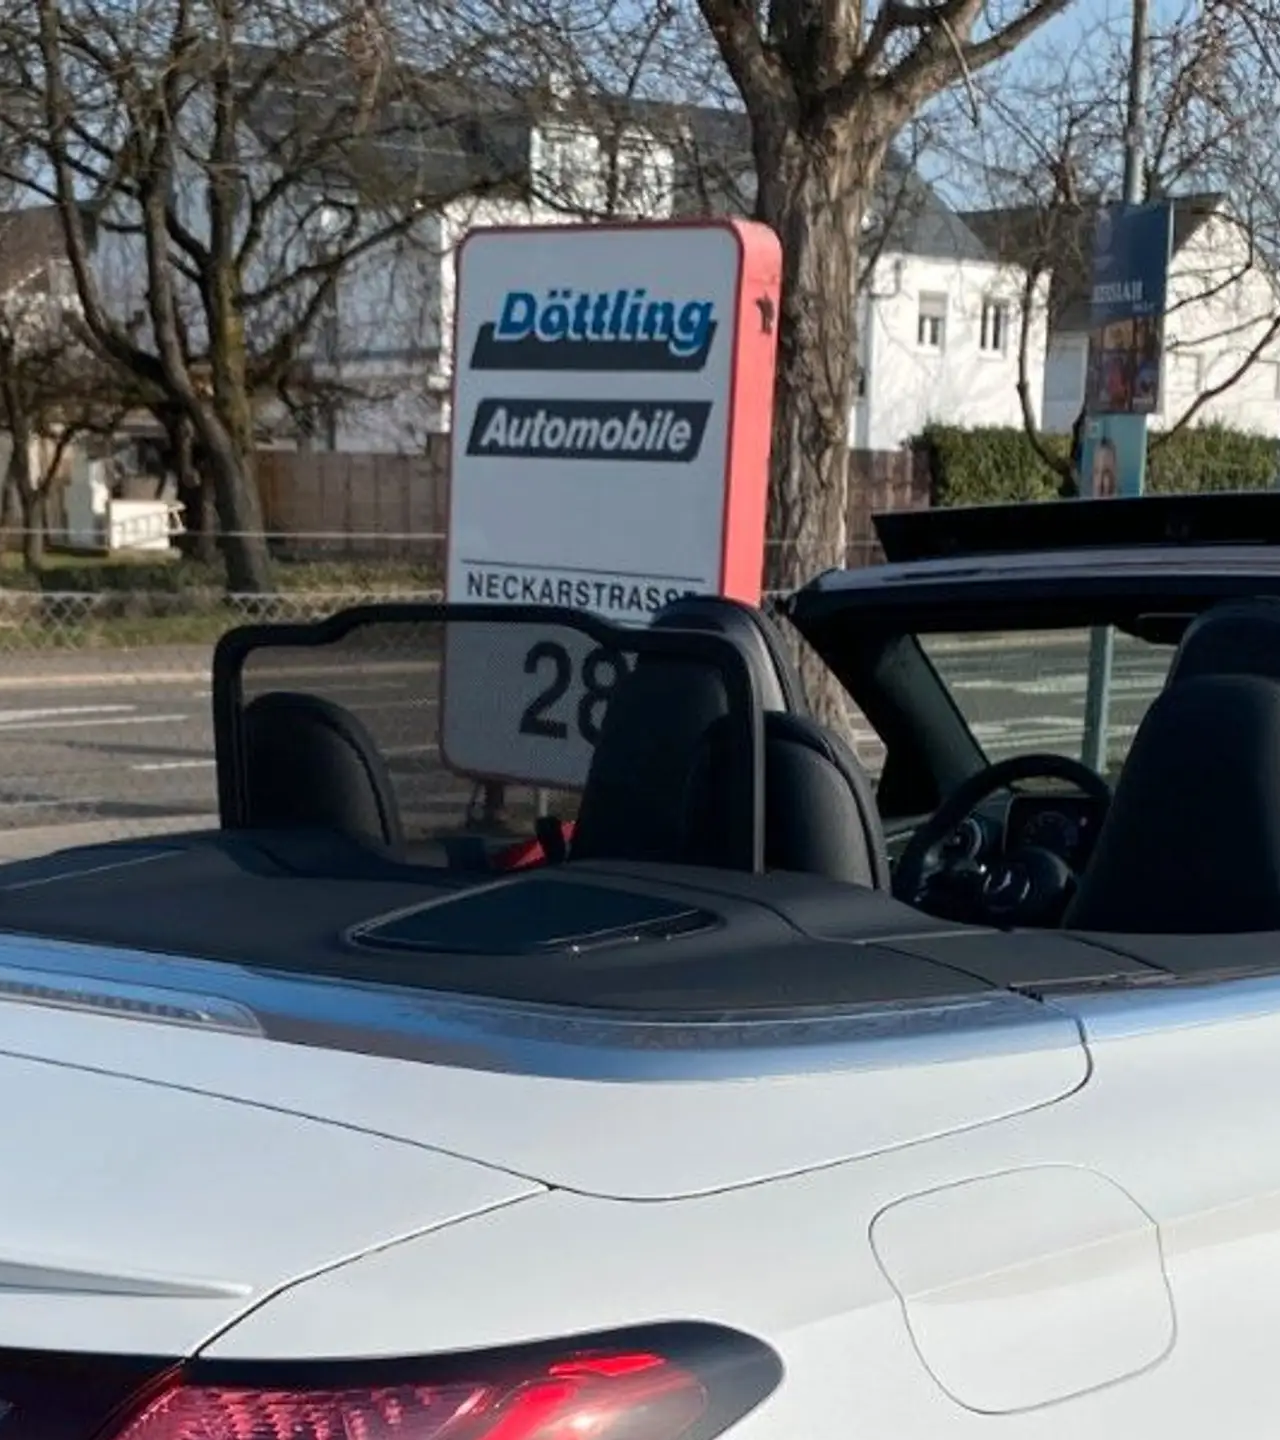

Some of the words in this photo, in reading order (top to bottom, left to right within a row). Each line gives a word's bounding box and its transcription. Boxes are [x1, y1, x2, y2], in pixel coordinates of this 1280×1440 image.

[494, 289, 714, 356] Döttling
[480, 407, 692, 453] Automobile
[467, 571, 696, 614] NECKARSTRASS
